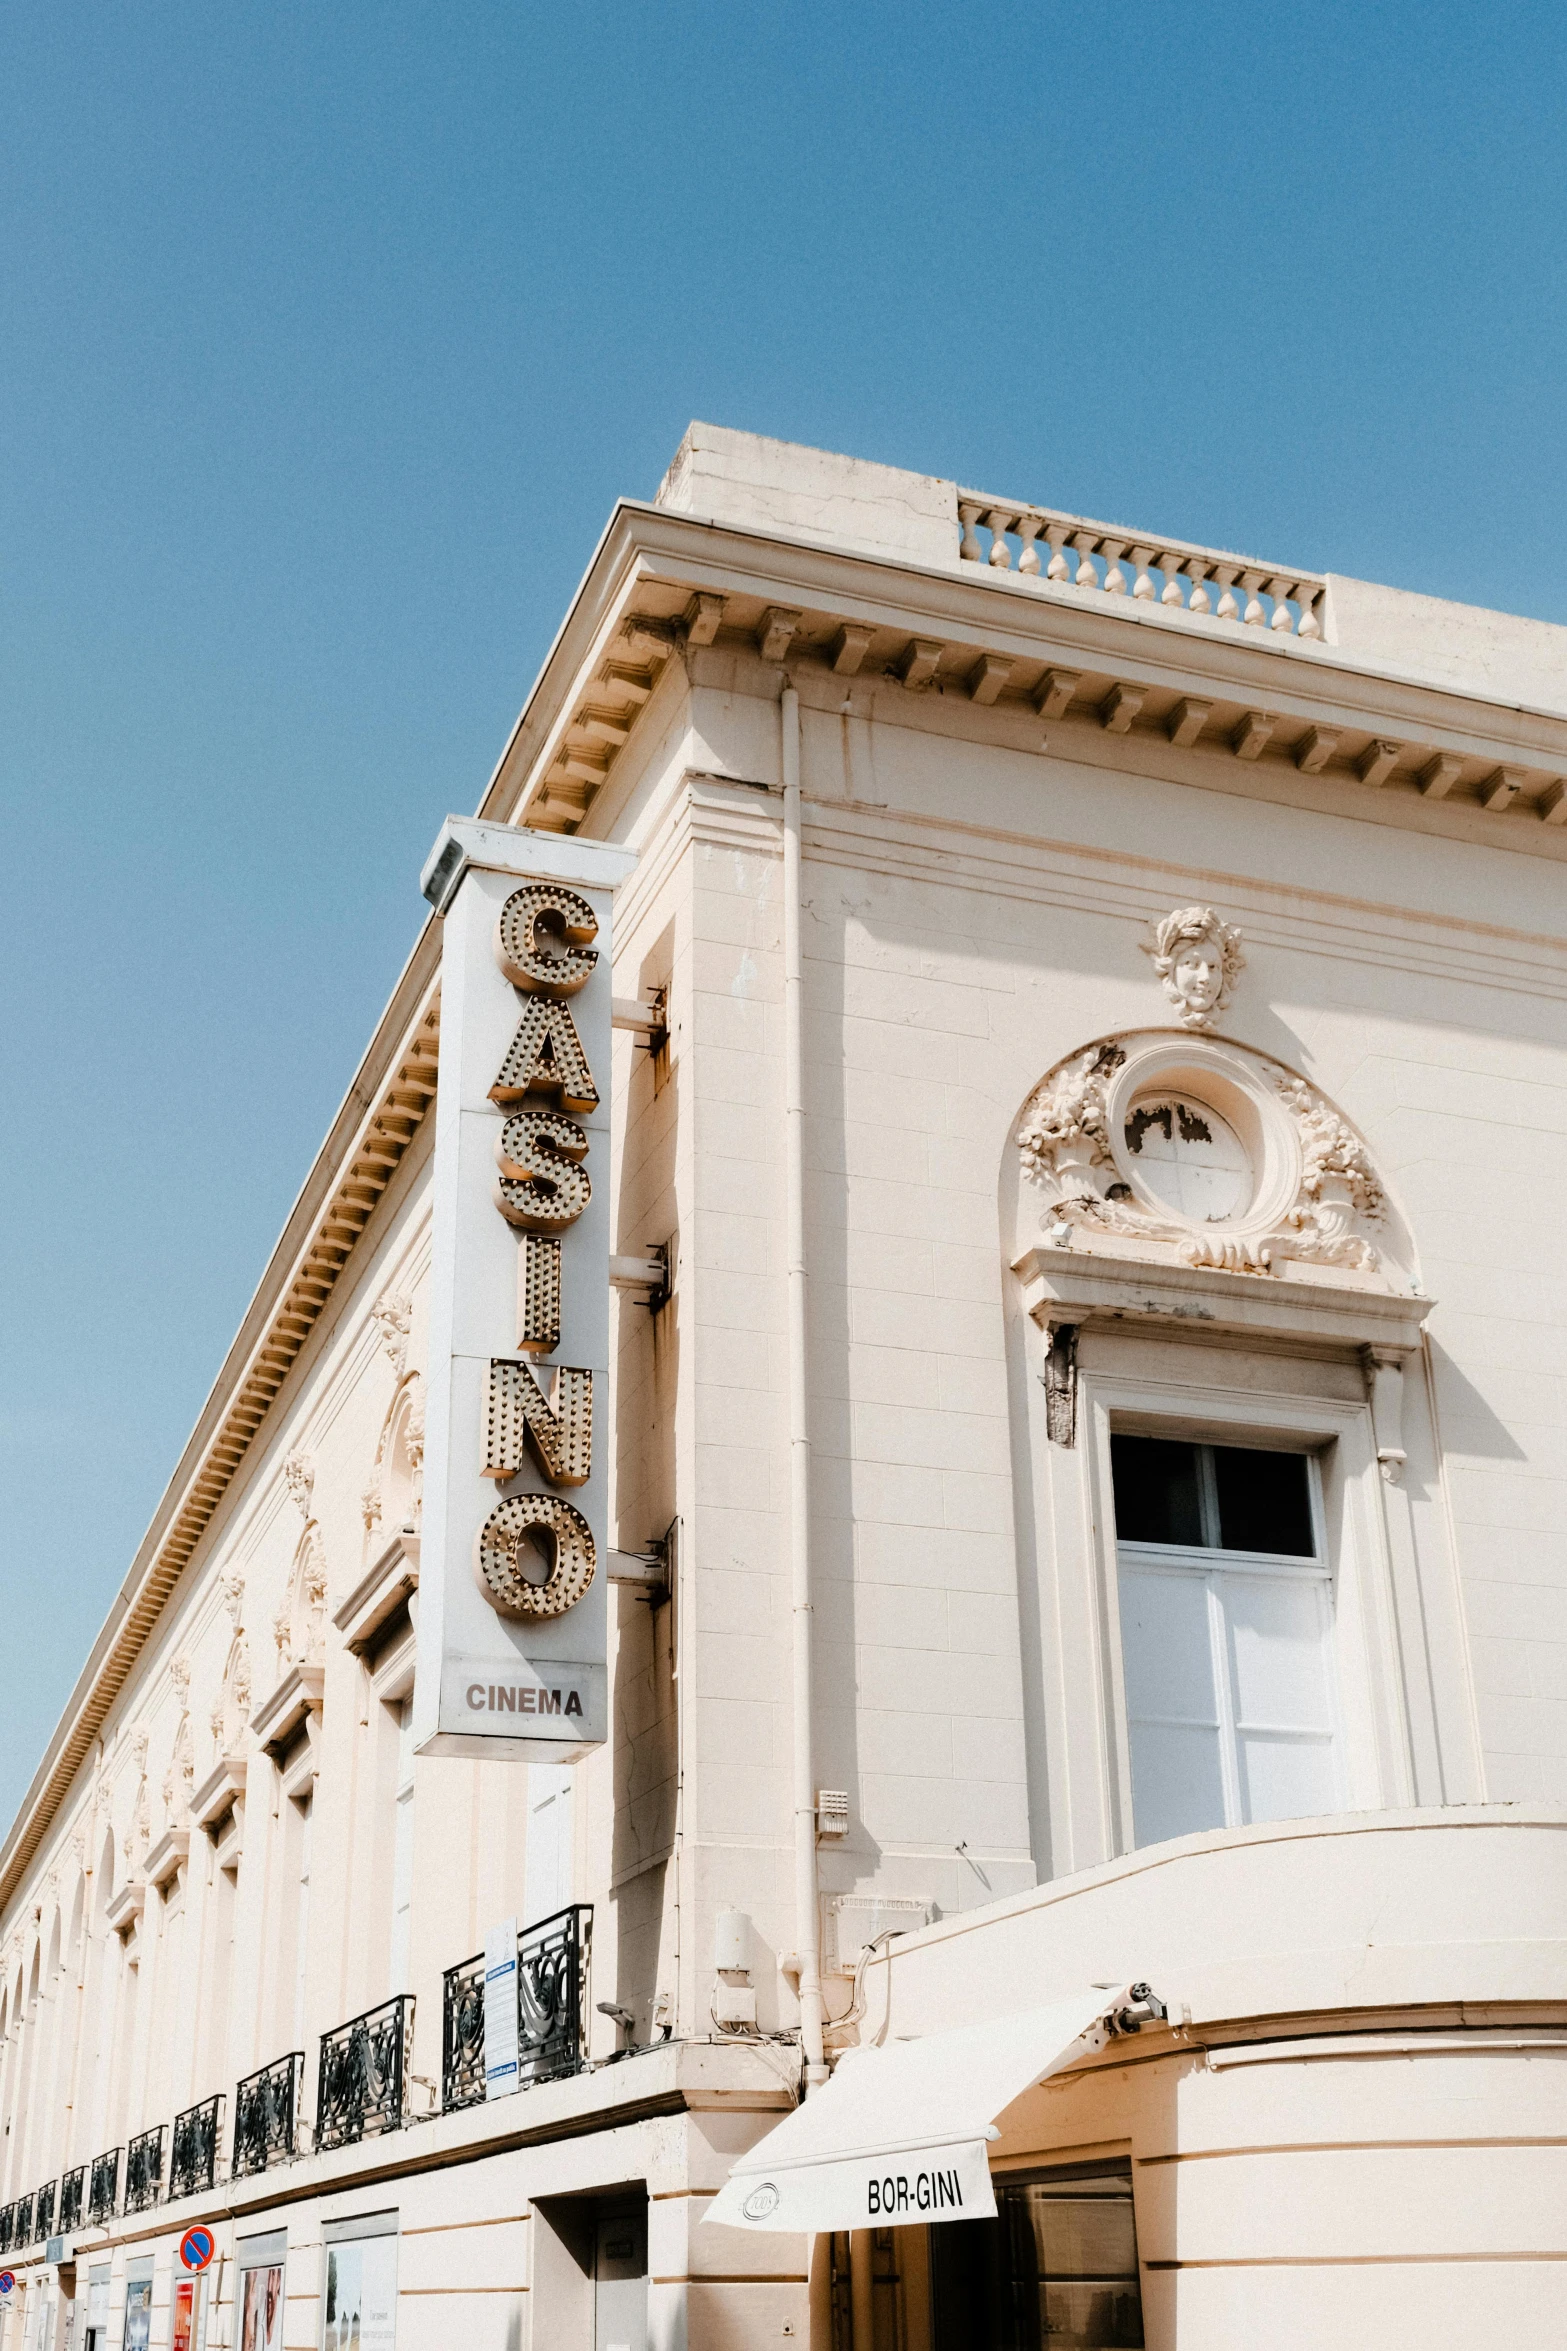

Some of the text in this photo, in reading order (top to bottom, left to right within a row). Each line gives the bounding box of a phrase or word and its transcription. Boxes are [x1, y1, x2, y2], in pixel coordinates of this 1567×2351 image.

[475, 885, 600, 1619] CASINO
[466, 1683, 584, 1717] CINEMA
[868, 2169, 964, 2215] BOR-GINI
